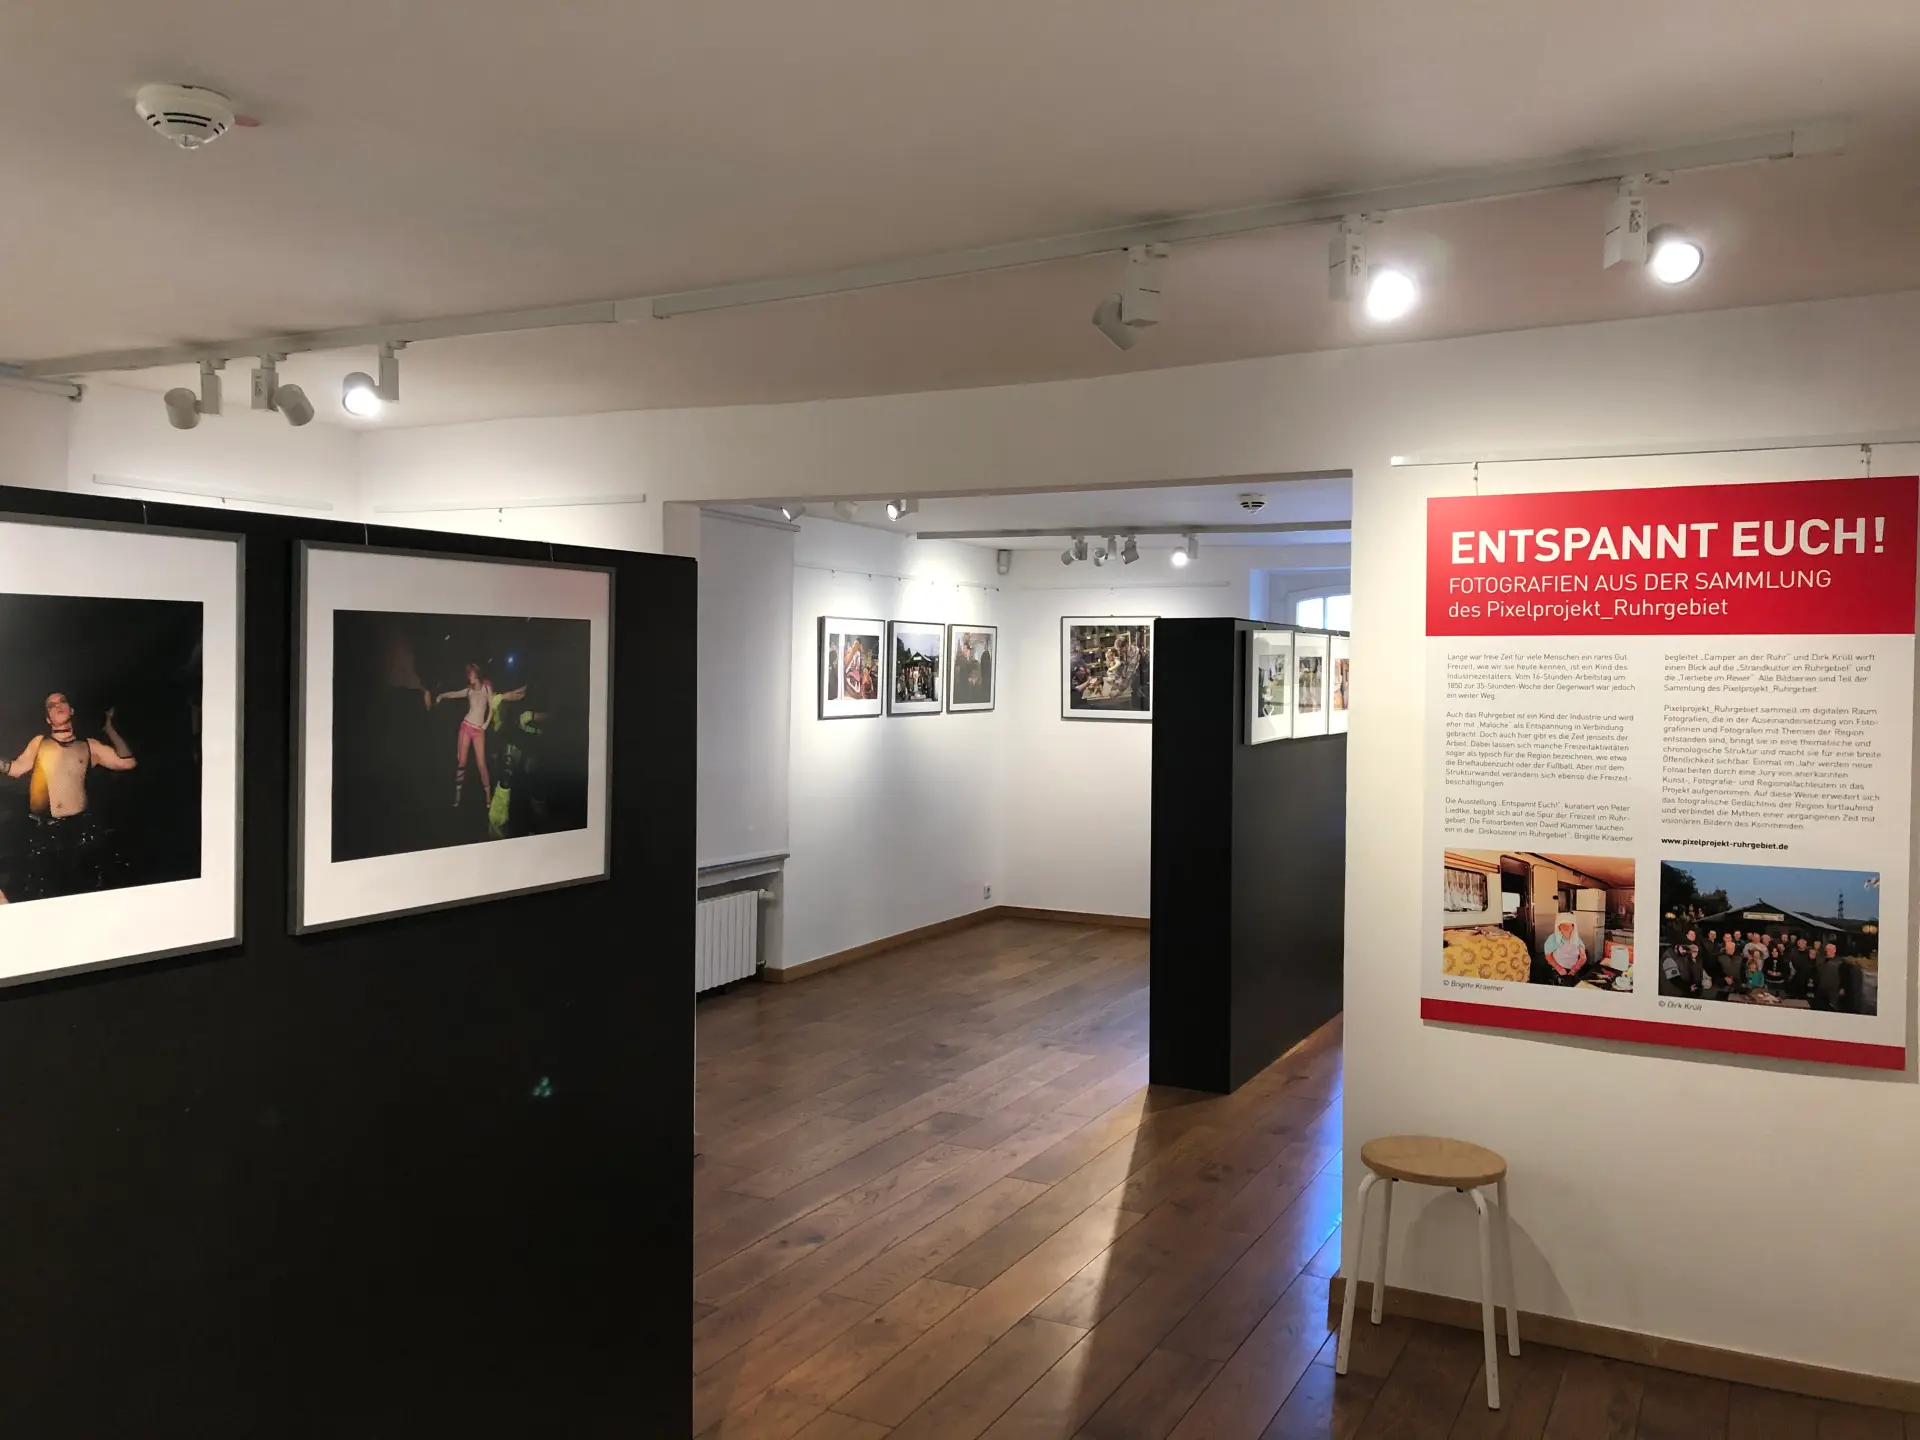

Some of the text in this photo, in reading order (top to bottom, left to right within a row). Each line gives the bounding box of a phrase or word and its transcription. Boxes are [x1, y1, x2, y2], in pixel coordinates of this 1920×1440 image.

[1452, 517, 1886, 564] ENTSPANNT EUCH!
[1450, 570, 1831, 594] FOTOGRAFIEN AUS DER SAMMLUNG
[1448, 598, 1728, 622] des Pixelprojekt_Ruhrgebiet
[1661, 838, 1788, 851] www.pixelprojekt-ruhrgebiet.de
